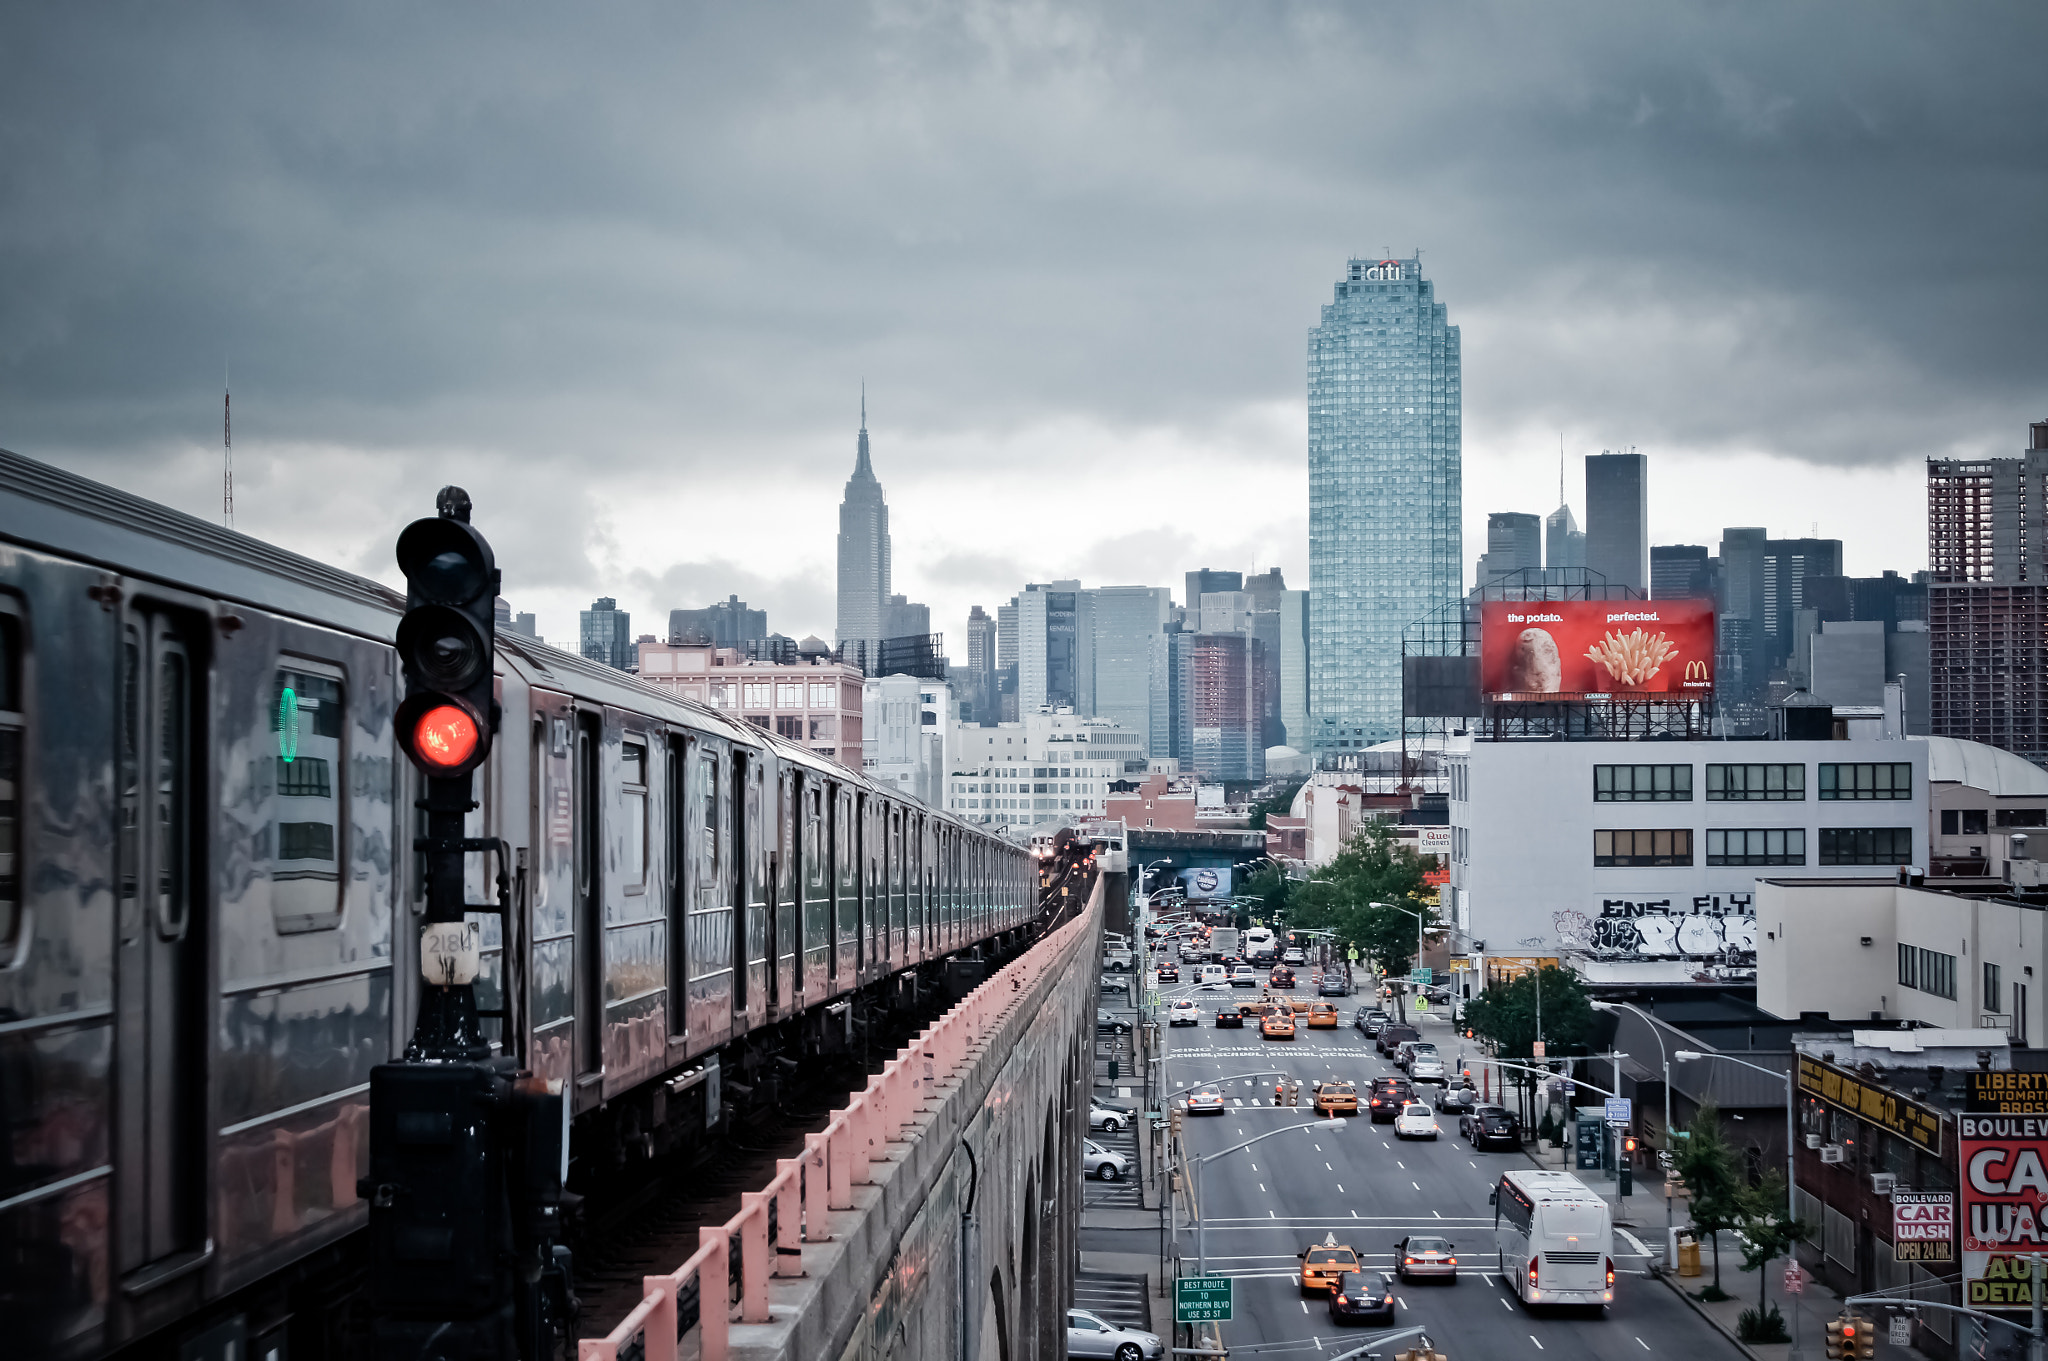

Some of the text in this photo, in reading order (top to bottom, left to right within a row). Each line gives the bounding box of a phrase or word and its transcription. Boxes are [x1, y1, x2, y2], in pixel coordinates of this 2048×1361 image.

[1366, 263, 1400, 280] citi
[1507, 613, 1564, 624] the potato.
[1606, 611, 1660, 623] perfected.
[1426, 831, 1450, 840] Que
[1896, 1194, 1951, 1203] BOULEVARD
[1896, 1205, 1951, 1221] CAR
[1897, 1225, 1950, 1239] WASH
[1897, 1241, 1951, 1260] OPEN 24 HR.
[1183, 1280, 1225, 1289] BEST ROUTE
[1200, 1292, 1209, 1300] TO
[1179, 1300, 1230, 1309] NORTHERN BLVD
[1187, 1309, 1221, 1318] USE 35 ST
